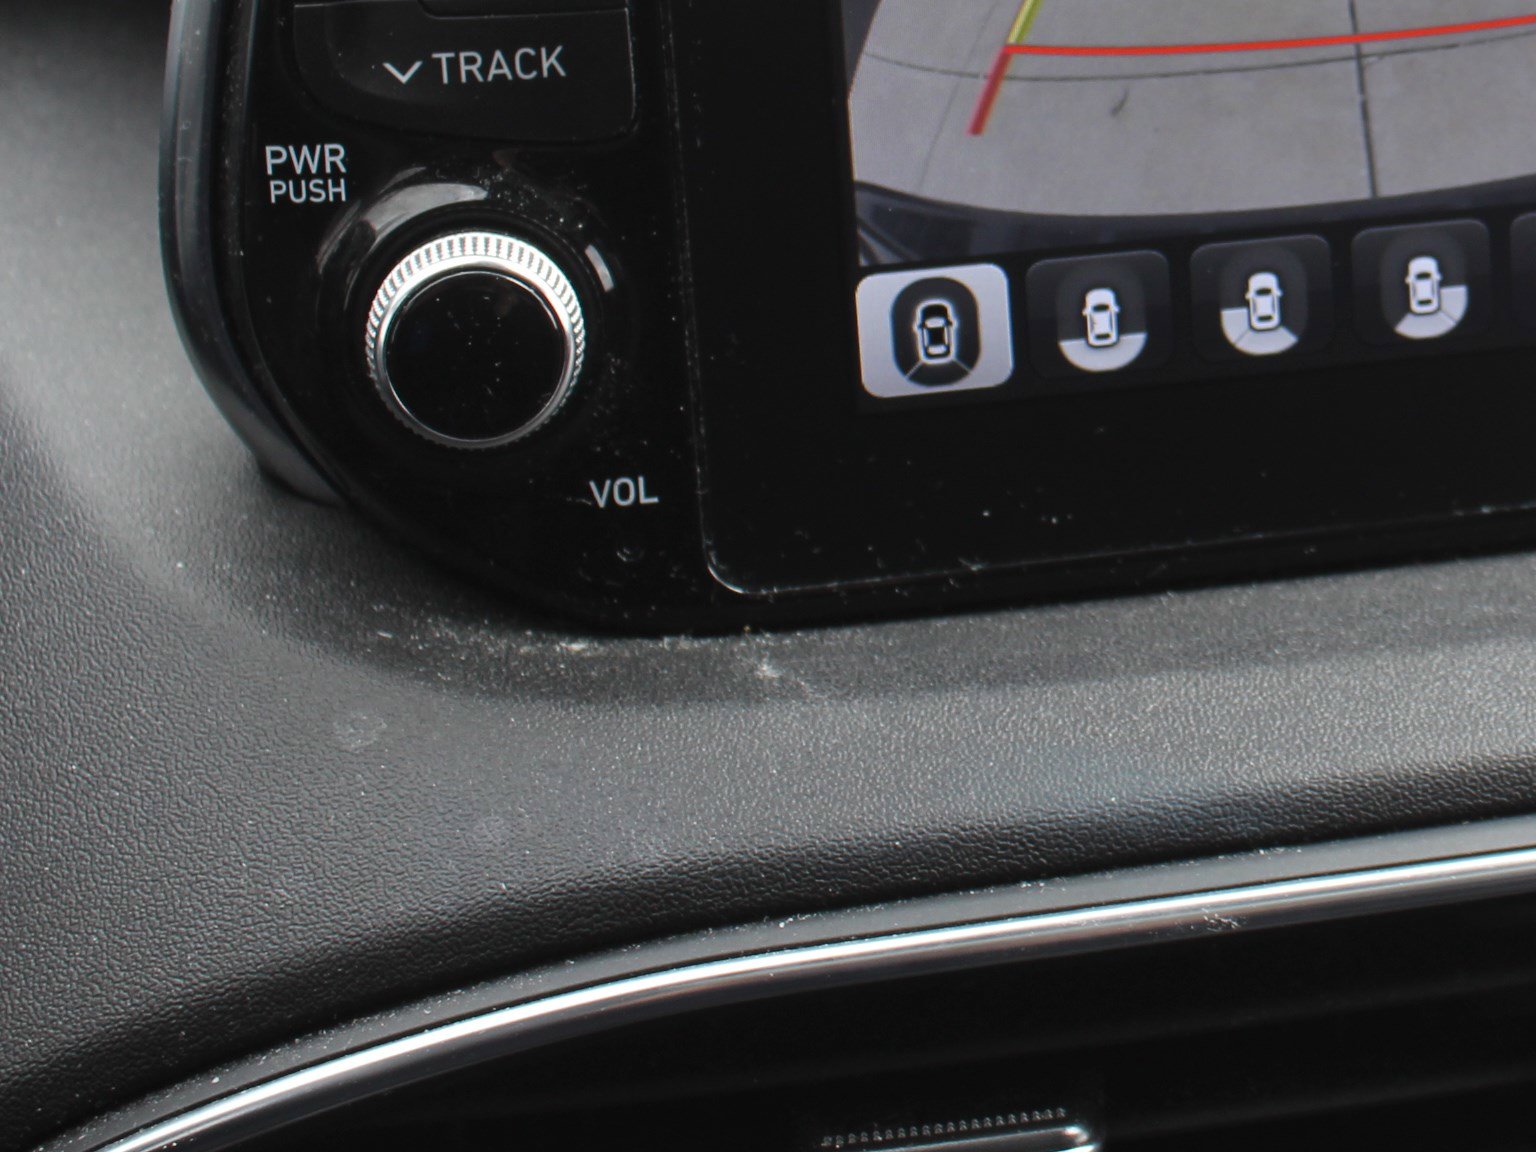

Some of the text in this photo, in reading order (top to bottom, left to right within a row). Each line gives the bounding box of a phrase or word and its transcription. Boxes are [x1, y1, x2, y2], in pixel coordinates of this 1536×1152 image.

[431, 45, 567, 85] TRACK
[264, 142, 347, 176] PWR
[269, 178, 347, 204] PUSH
[589, 475, 660, 508] VOL
